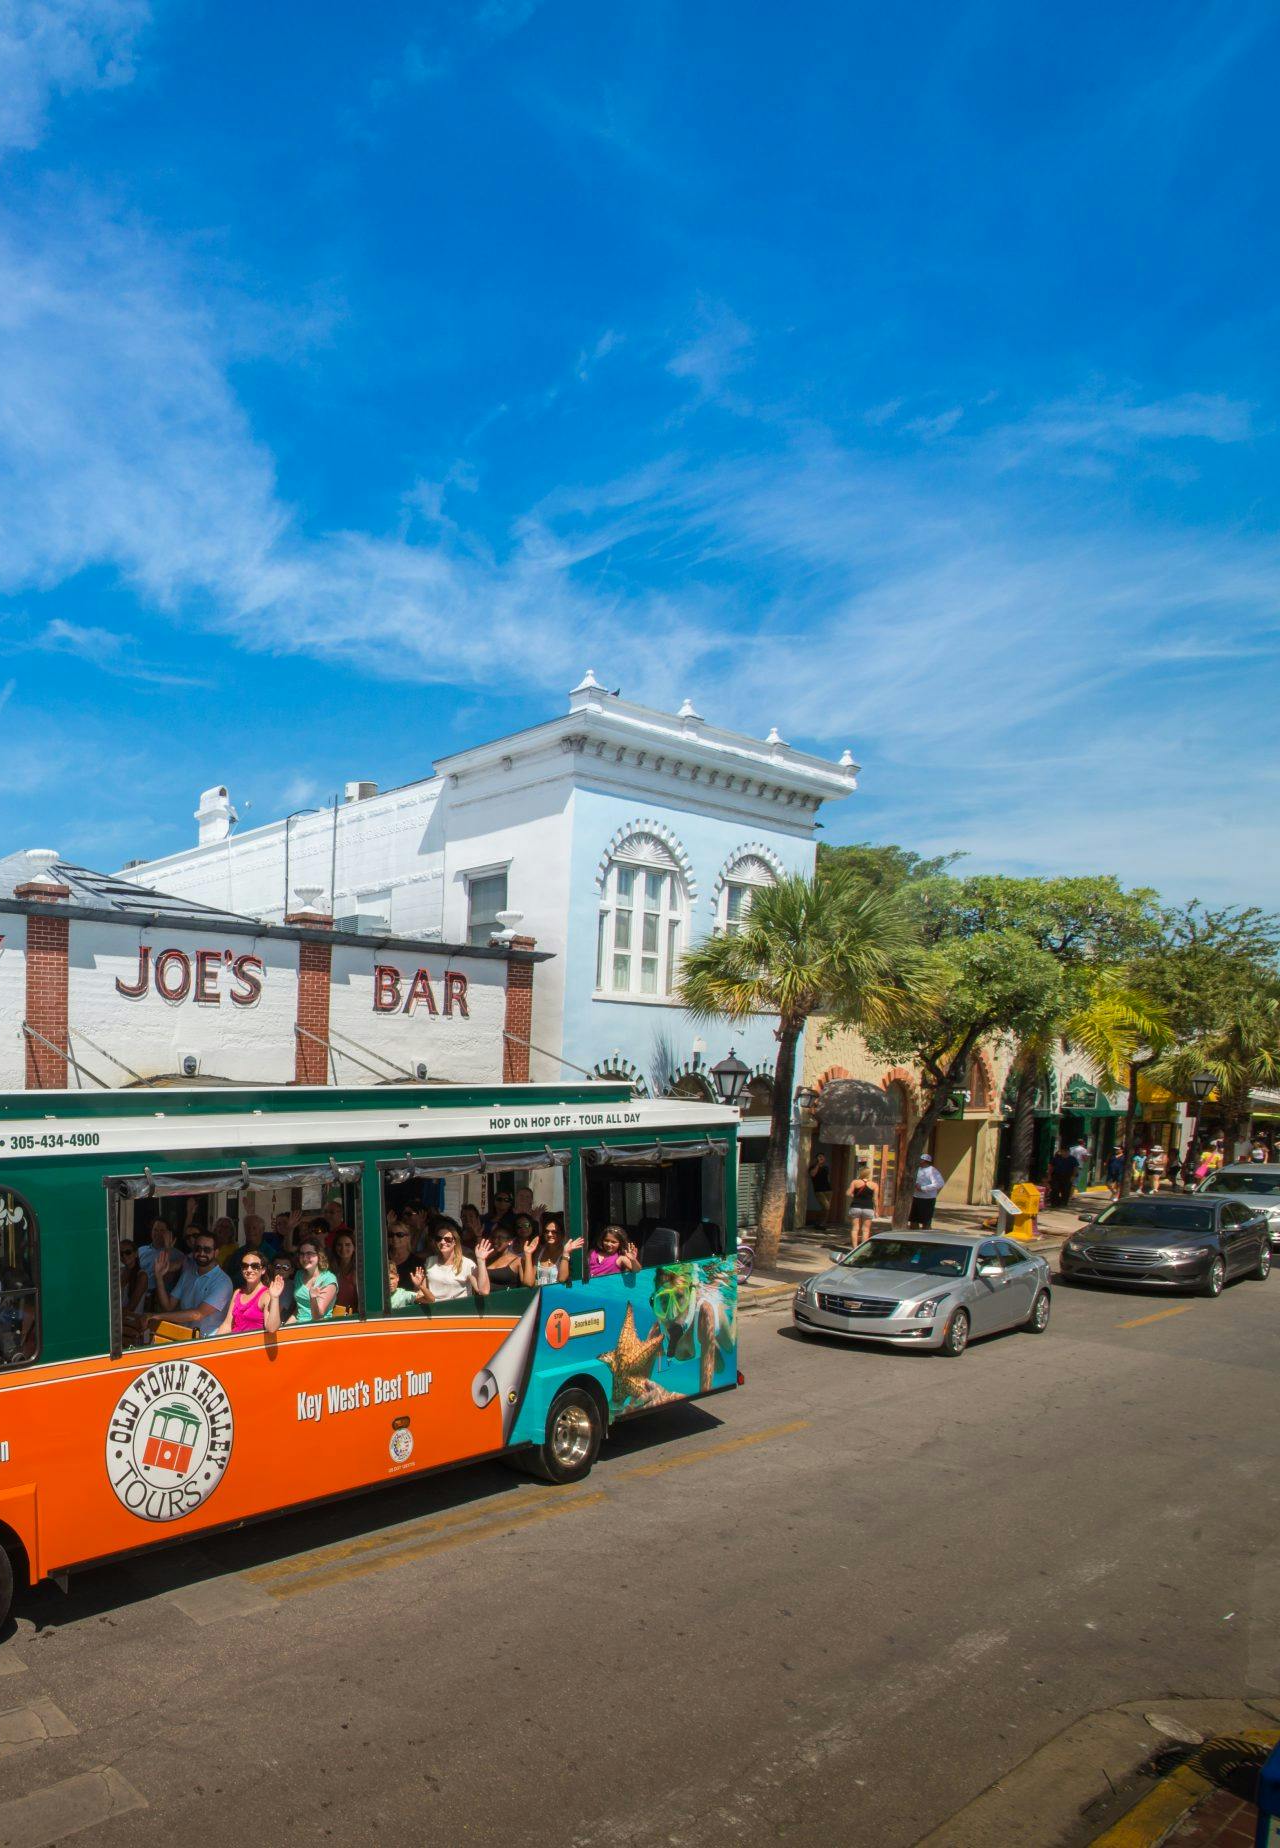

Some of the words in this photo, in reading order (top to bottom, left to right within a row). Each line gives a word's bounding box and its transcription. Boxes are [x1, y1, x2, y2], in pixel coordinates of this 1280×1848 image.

[115, 946, 263, 1005] JOE'S
[372, 964, 470, 1018] BAR
[489, 1118, 511, 1130] HOP
[513, 1117, 528, 1129] ON
[531, 1116, 551, 1128] HOP
[554, 1115, 571, 1127] OFF
[579, 1114, 603, 1126] TOUR
[606, 1113, 621, 1125] ALL
[624, 1112, 641, 1123] DAY
[10, 1132, 100, 1150] 305-434-4900
[554, 1320, 562, 1344] 1
[574, 1318, 600, 1329] Snorkeling
[297, 1391, 323, 1423] Key
[326, 1380, 371, 1415] West's
[373, 1374, 403, 1405] Best
[405, 1370, 433, 1398] Tour
[109, 1398, 141, 1444] OLD
[133, 1363, 190, 1404] TOWN
[191, 1369, 232, 1470] TROLLEY
[113, 1460, 203, 1520] TOURS
